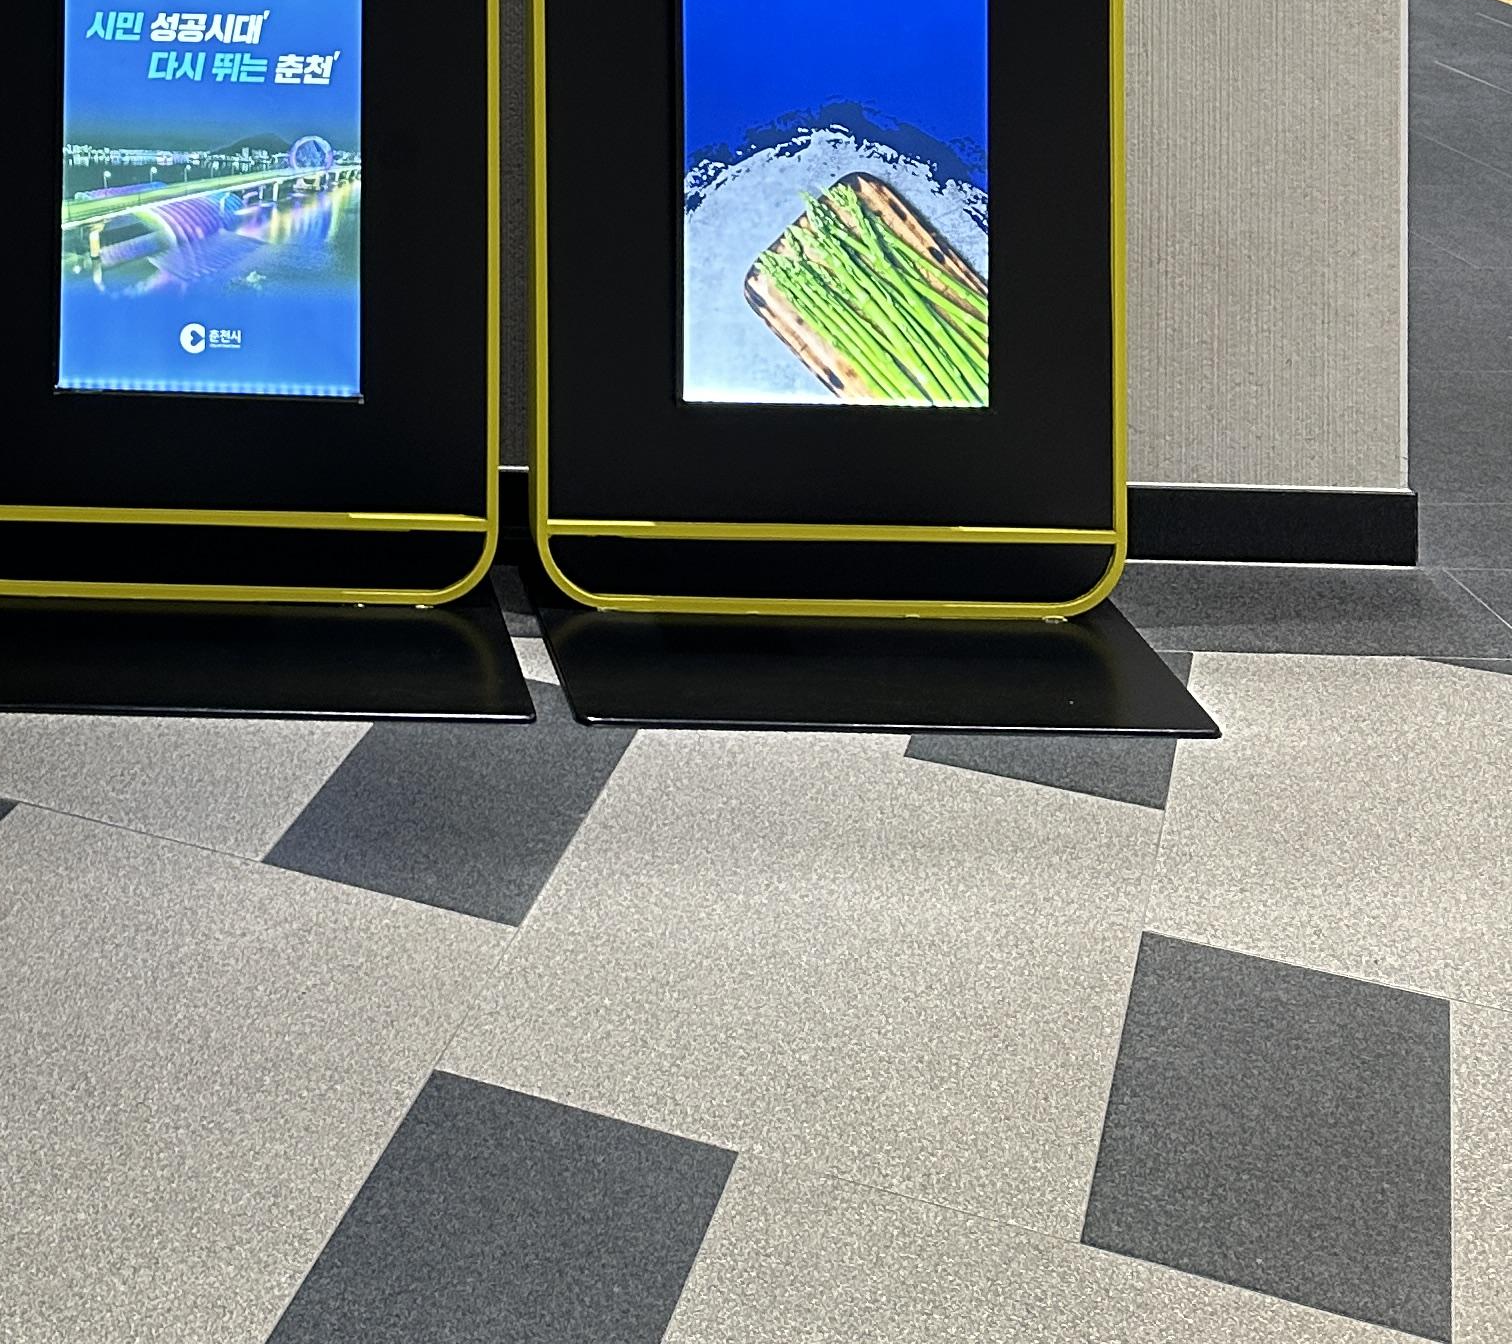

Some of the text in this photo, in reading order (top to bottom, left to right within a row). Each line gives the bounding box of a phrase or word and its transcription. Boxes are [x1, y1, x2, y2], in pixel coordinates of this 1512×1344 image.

[86, 11, 144, 41] 시민
[148, 51, 205, 81] 다시
[212, 53, 268, 82] 뛰는
[209, 329, 242, 343] 춘천시
